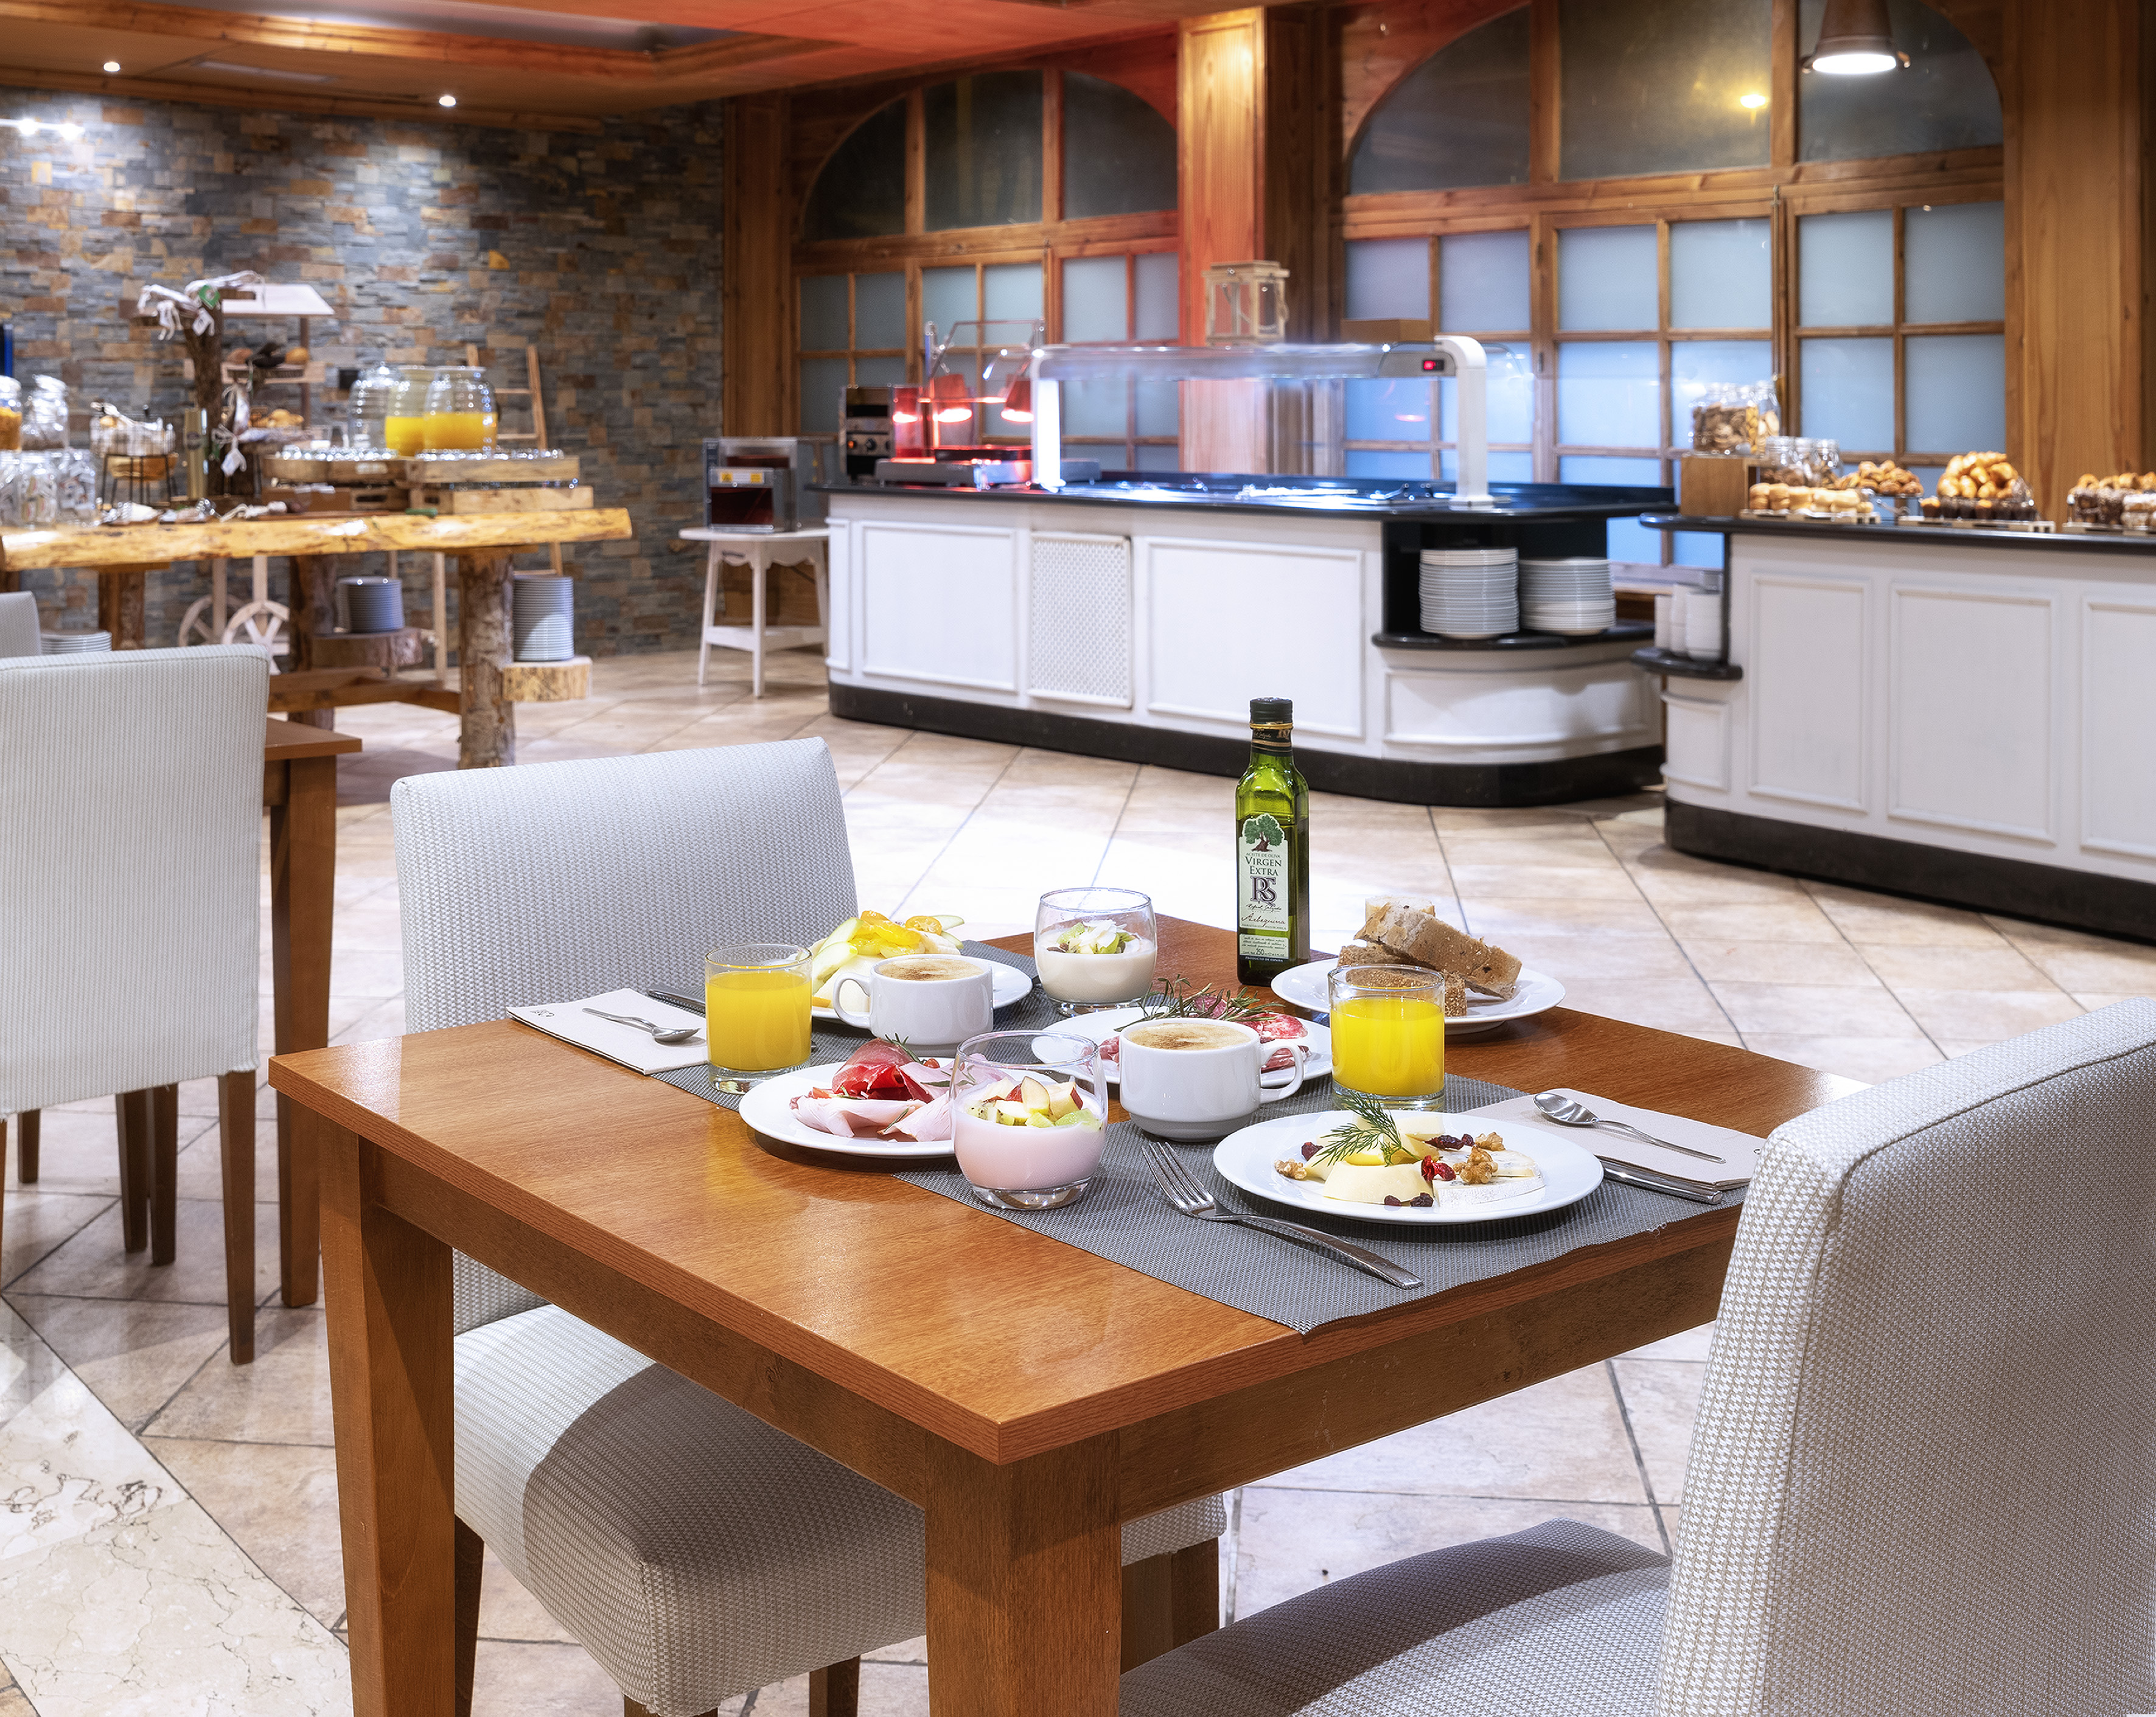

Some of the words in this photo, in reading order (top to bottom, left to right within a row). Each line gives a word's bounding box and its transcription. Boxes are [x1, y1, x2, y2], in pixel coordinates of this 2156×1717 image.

[1245, 856, 1282, 866] VIRGEN
[1250, 866, 1278, 876] EXTRA
[1250, 876, 1277, 907] RS
